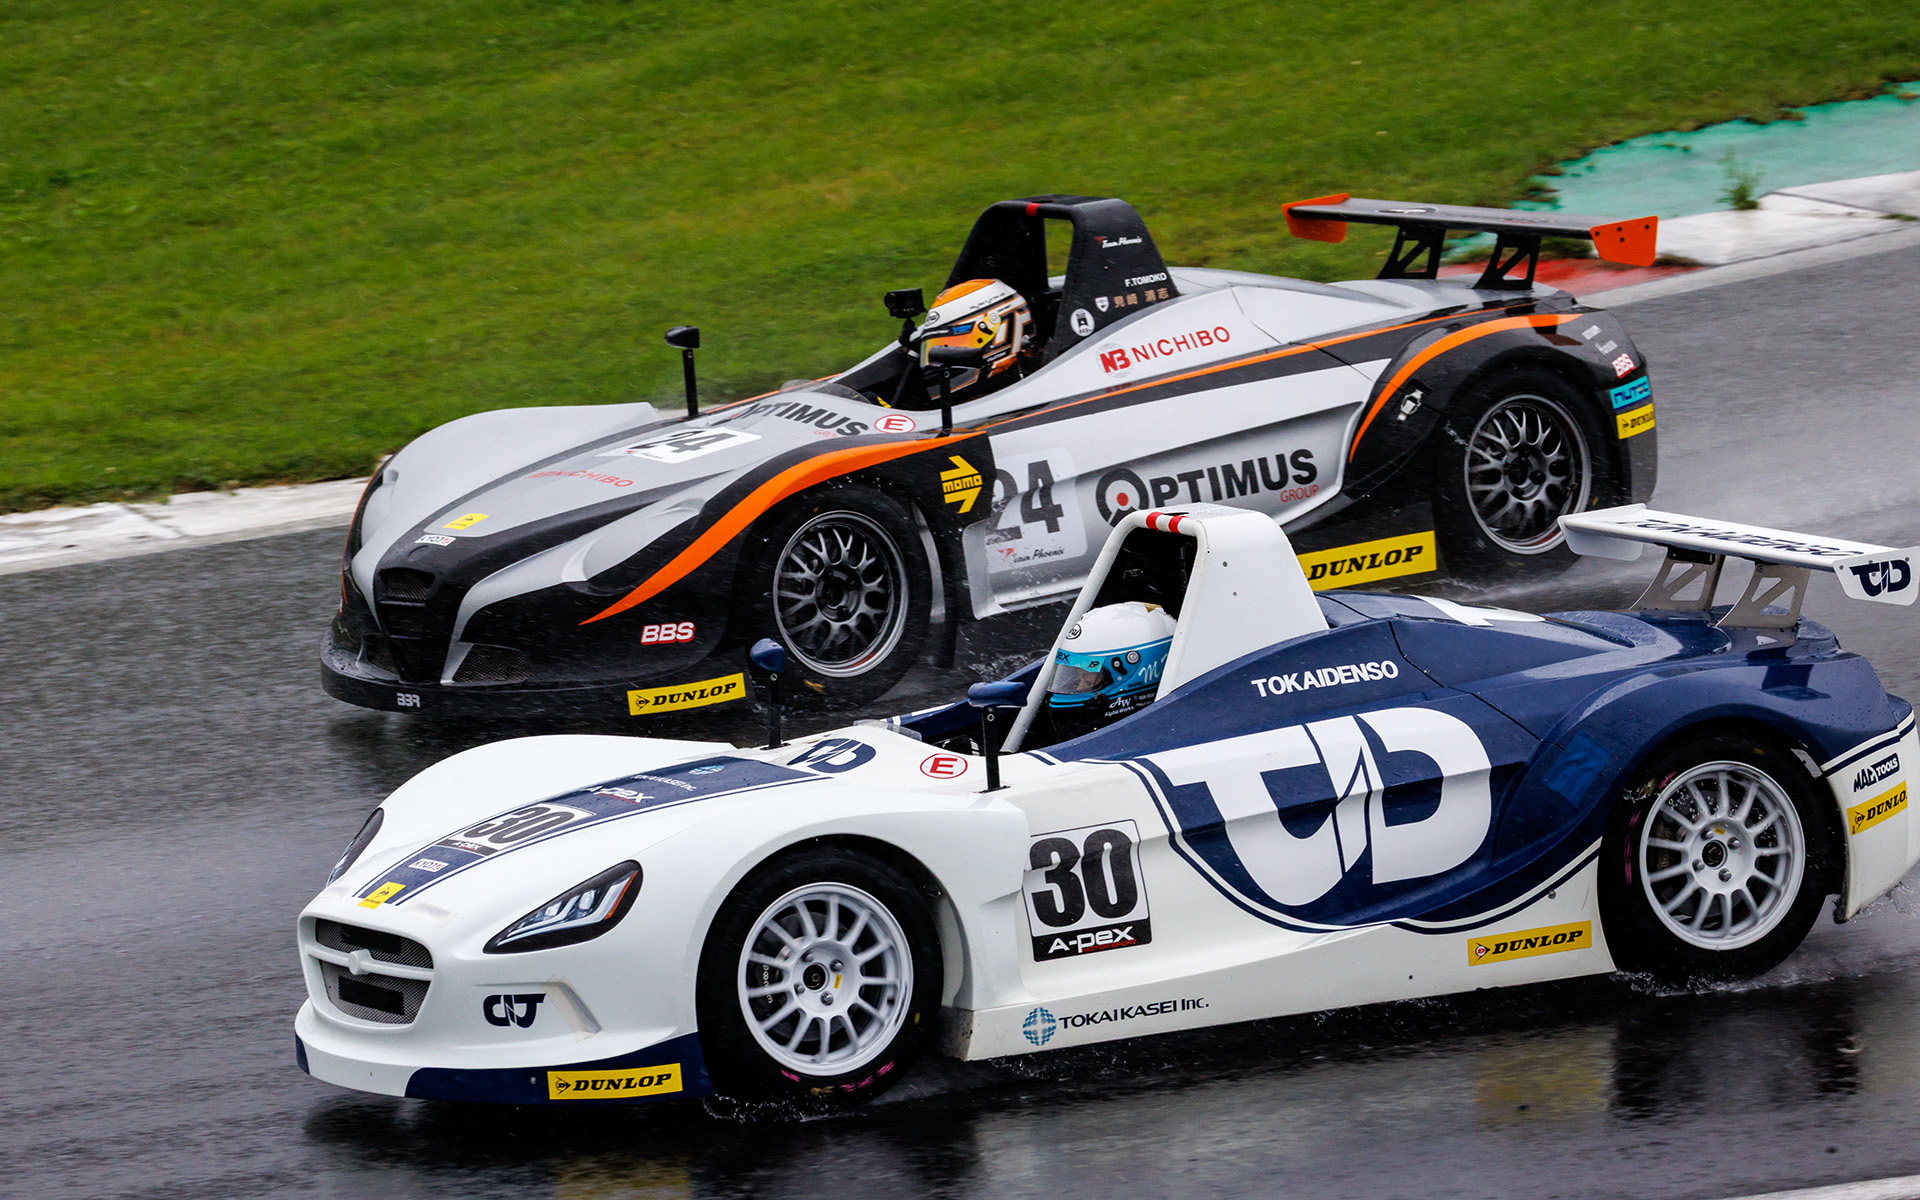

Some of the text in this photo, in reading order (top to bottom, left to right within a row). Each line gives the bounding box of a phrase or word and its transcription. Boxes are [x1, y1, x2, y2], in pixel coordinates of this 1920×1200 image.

[1125, 272, 1167, 287] F.TOMOKO
[1131, 326, 1230, 362] NICHIBO
[1612, 353, 1636, 379] BBS
[883, 418, 907, 431] E
[986, 459, 1064, 545] 24
[1280, 484, 1319, 503] GROUP
[1308, 545, 1423, 581] DUNLOP
[641, 621, 695, 645] BBS
[1251, 660, 1399, 697] TOKAIDENSO
[652, 682, 736, 706] DUNLOP
[929, 757, 959, 775] E
[1876, 758, 1898, 777] TOOLS
[1866, 789, 1908, 821] DUNLO
[463, 806, 575, 844] 30
[1029, 828, 1138, 928] 30
[1491, 930, 1583, 955] DUNLOP
[1059, 997, 1209, 1029] TOKAI KASEI Inc.
[573, 1073, 672, 1091] DUNLOP
